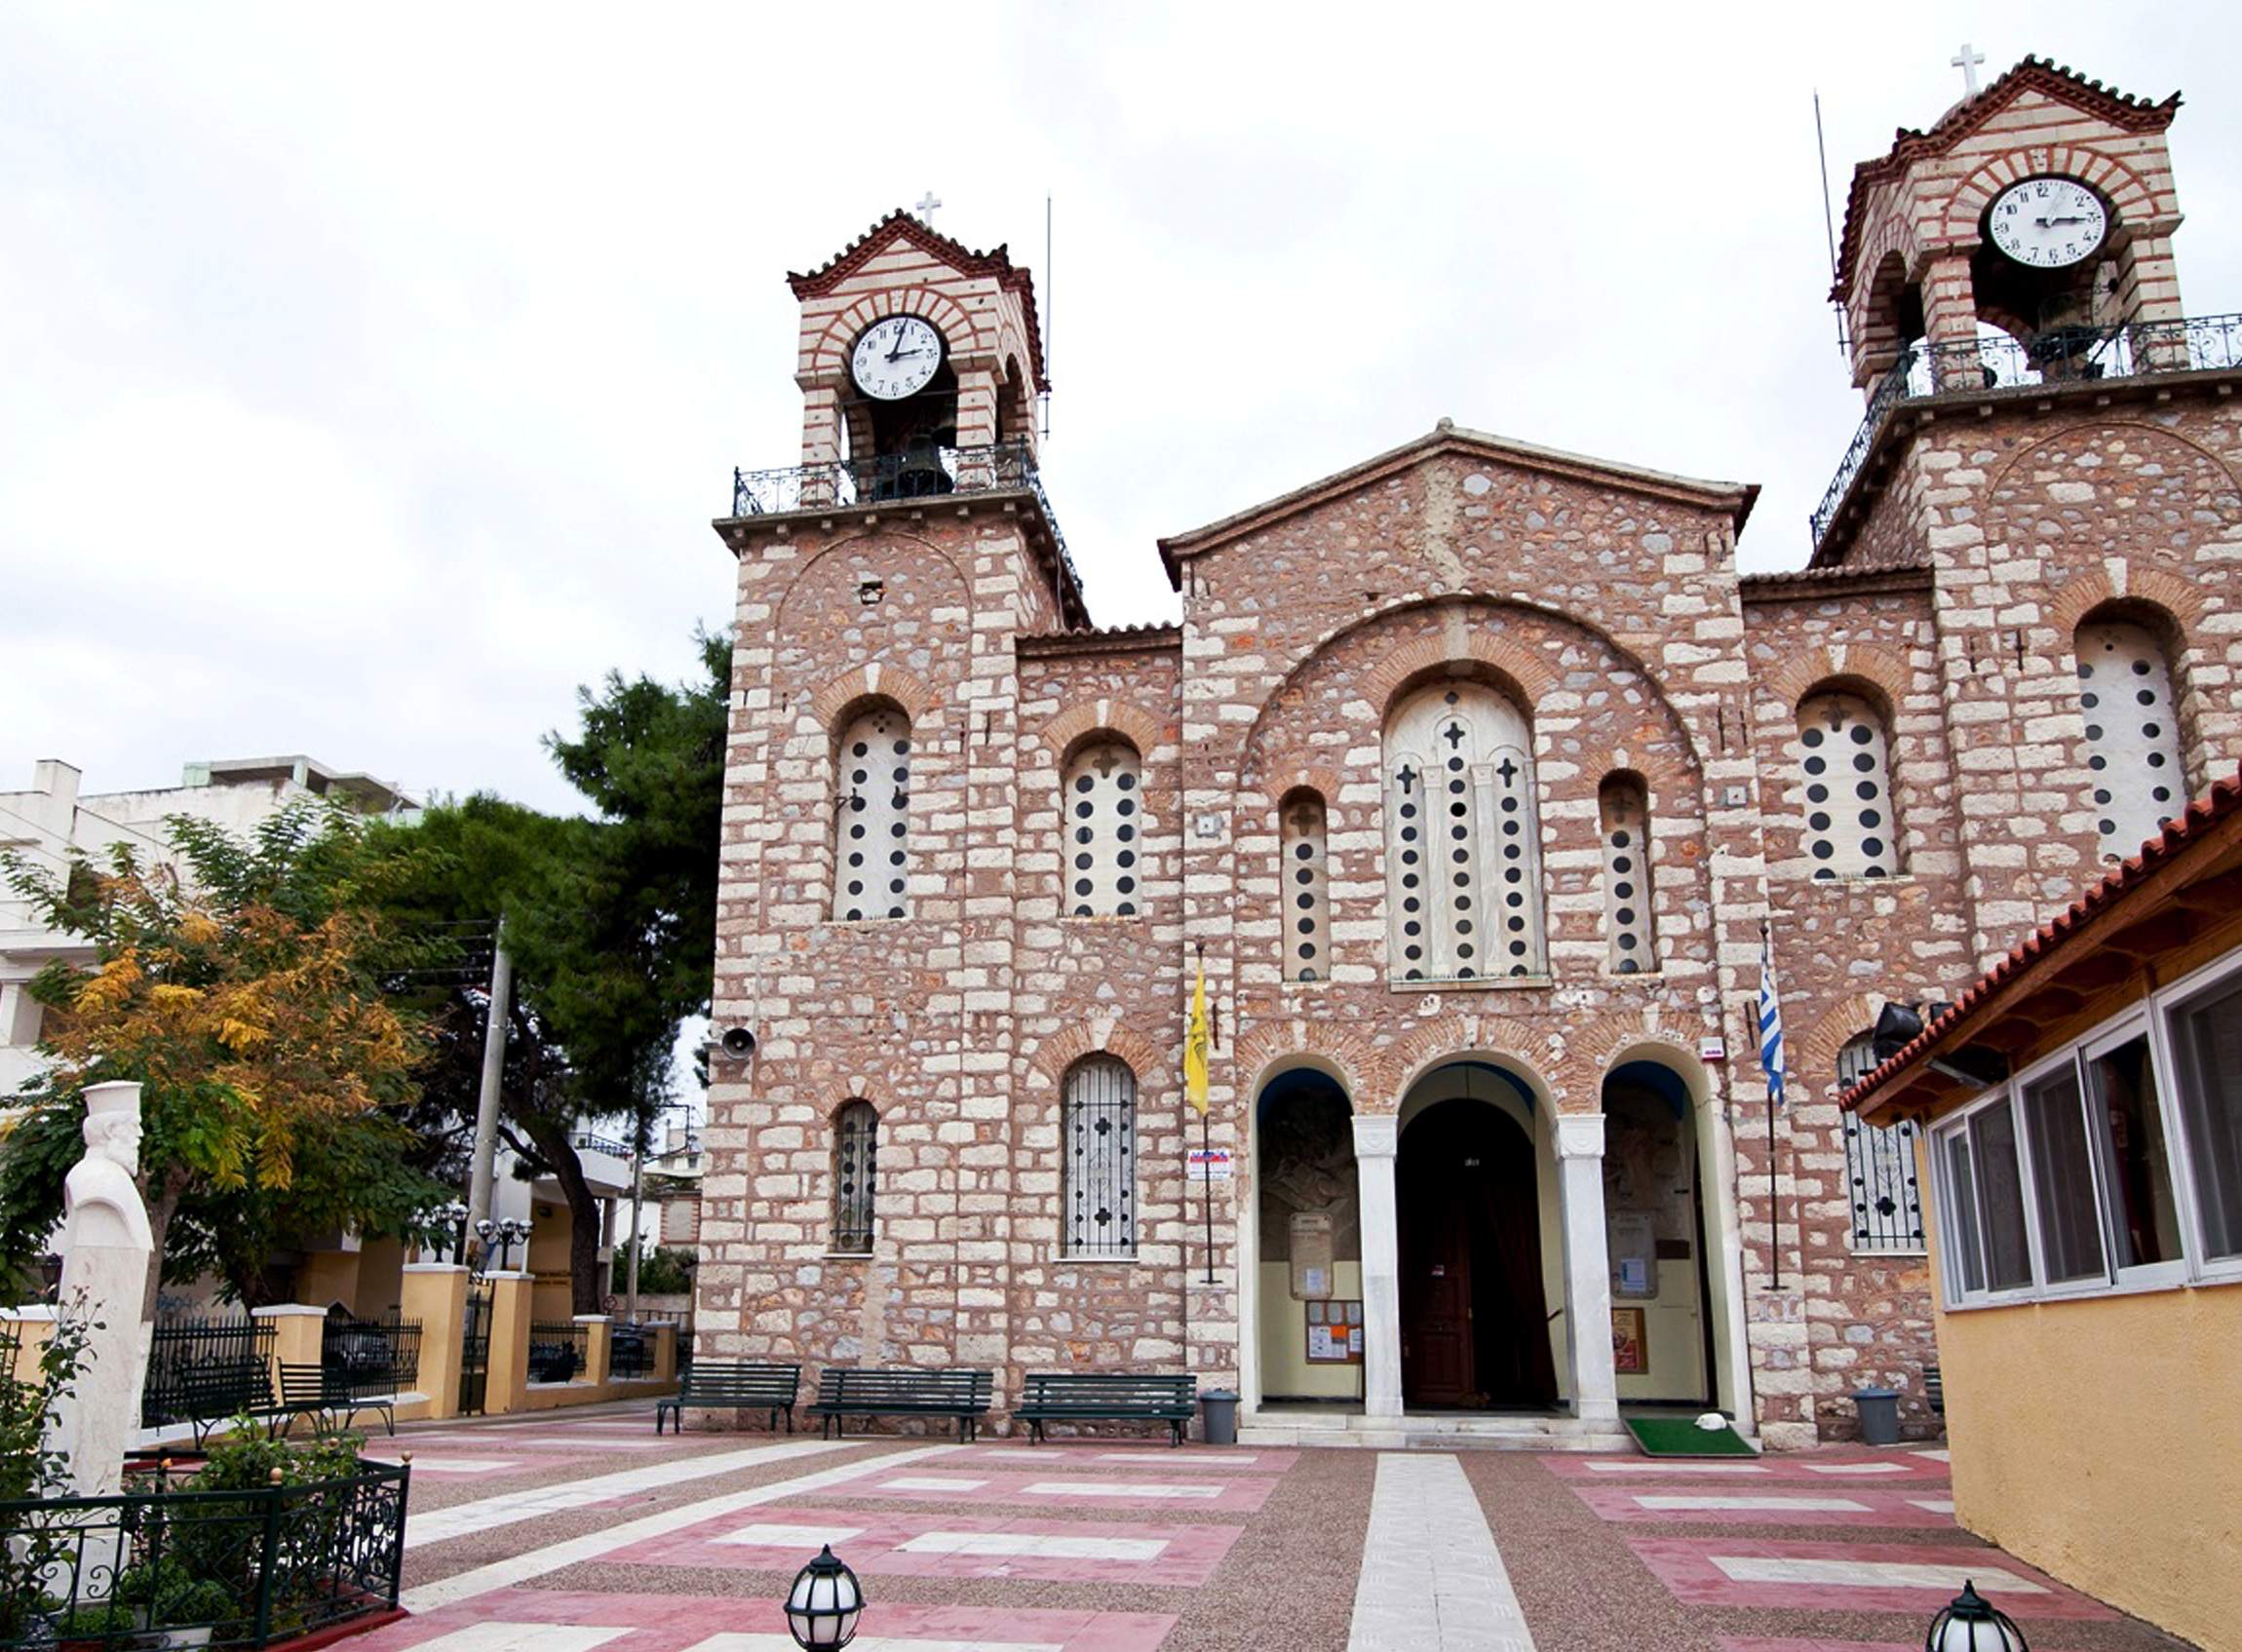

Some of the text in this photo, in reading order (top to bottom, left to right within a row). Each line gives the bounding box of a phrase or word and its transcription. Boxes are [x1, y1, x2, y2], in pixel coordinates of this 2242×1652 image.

[2020, 192, 2029, 203] 11
[2036, 187, 2049, 198] 12
[2075, 196, 2085, 208] 2
[2087, 212, 2097, 223] 3
[1999, 223, 2009, 234] 9
[2083, 230, 2091, 242] 4
[2030, 248, 2039, 259] 7
[2067, 243, 2076, 254] 5
[2049, 250, 2059, 259] 6
